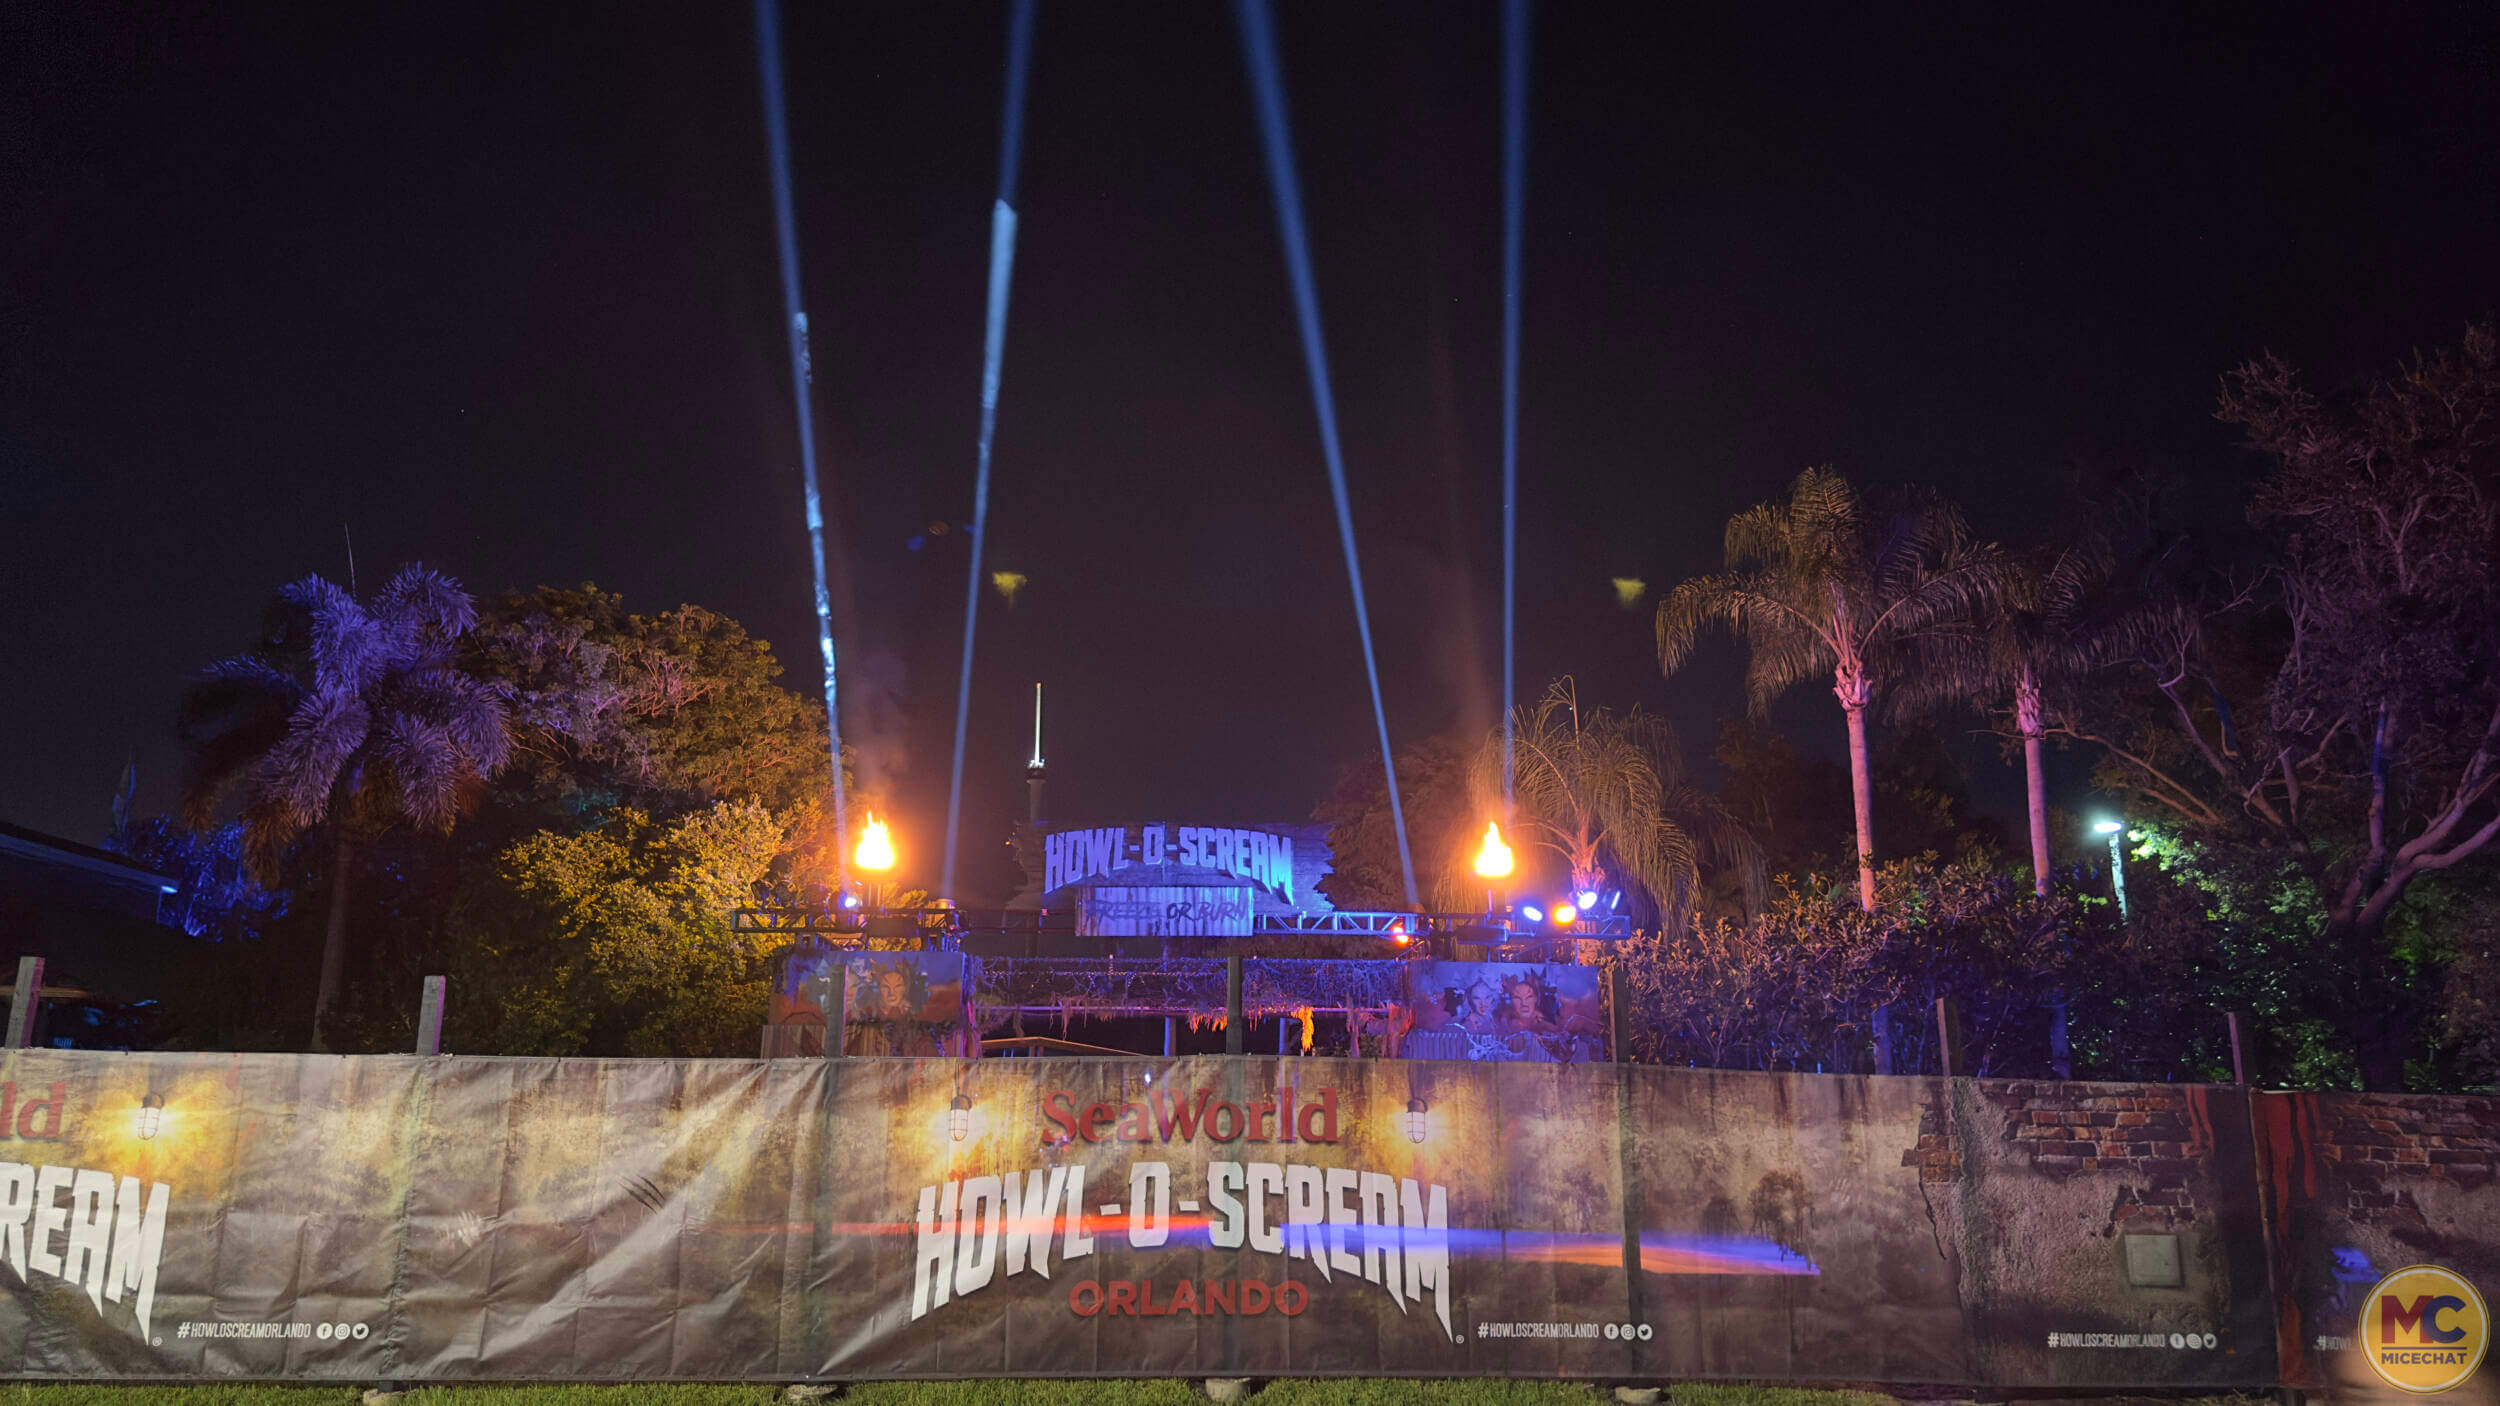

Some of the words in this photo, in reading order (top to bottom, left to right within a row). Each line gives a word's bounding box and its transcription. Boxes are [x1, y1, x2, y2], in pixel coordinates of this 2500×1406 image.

[1044, 825, 1295, 906] HOWL-O-SCREAM
[1166, 901, 1194, 922] OR
[1195, 901, 1247, 923] BURN
[1041, 1086, 1340, 1144] SeaWorld
[911, 1161, 1454, 1344] HOWL-O-SCREAM
[1069, 1279, 1309, 1317] ORLANDO
[177, 1321, 312, 1339] #HOWLOSCREAMORLANDO
[1477, 1322, 1600, 1339] #HOWLOSCREAMORLANDO
